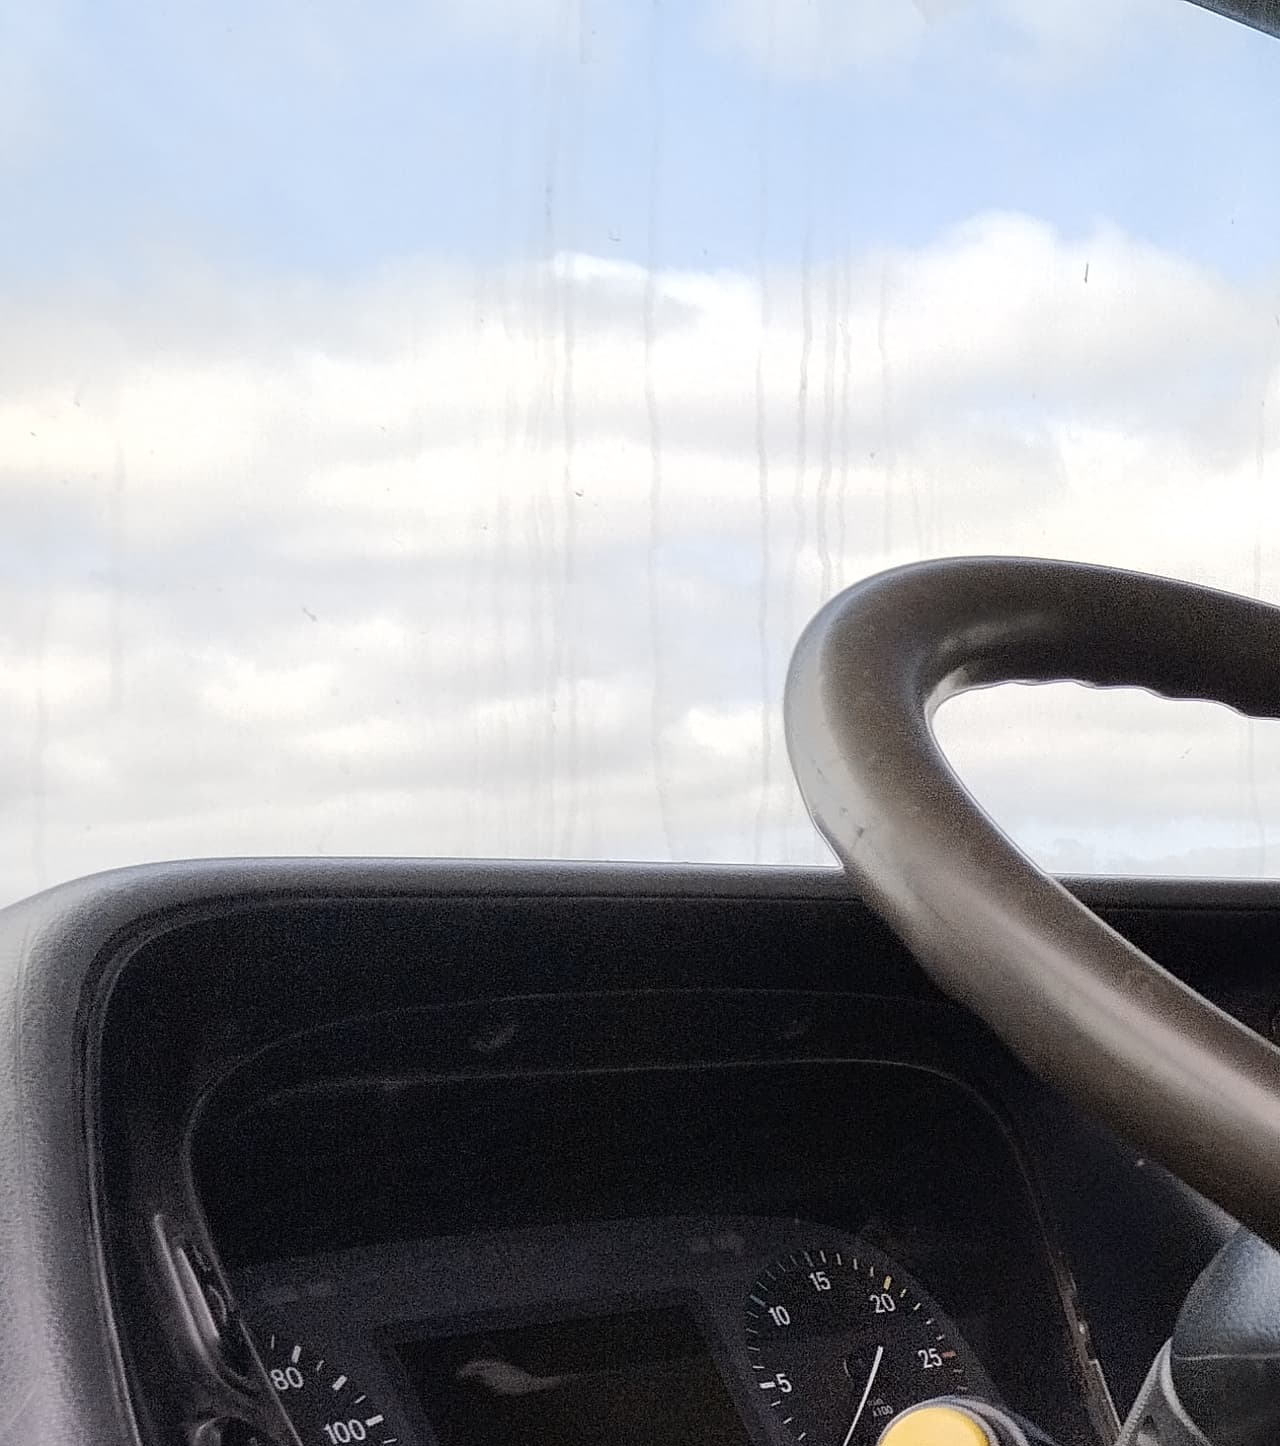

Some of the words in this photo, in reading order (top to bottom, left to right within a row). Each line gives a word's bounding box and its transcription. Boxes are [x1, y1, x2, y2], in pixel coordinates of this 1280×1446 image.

[808, 1271, 831, 1291] 15
[869, 1293, 896, 1313] 20
[768, 1305, 791, 1326] 10
[917, 1348, 943, 1369] 25
[270, 1366, 303, 1390] 80
[775, 1373, 792, 1393] 5
[323, 1418, 366, 1445] 100
